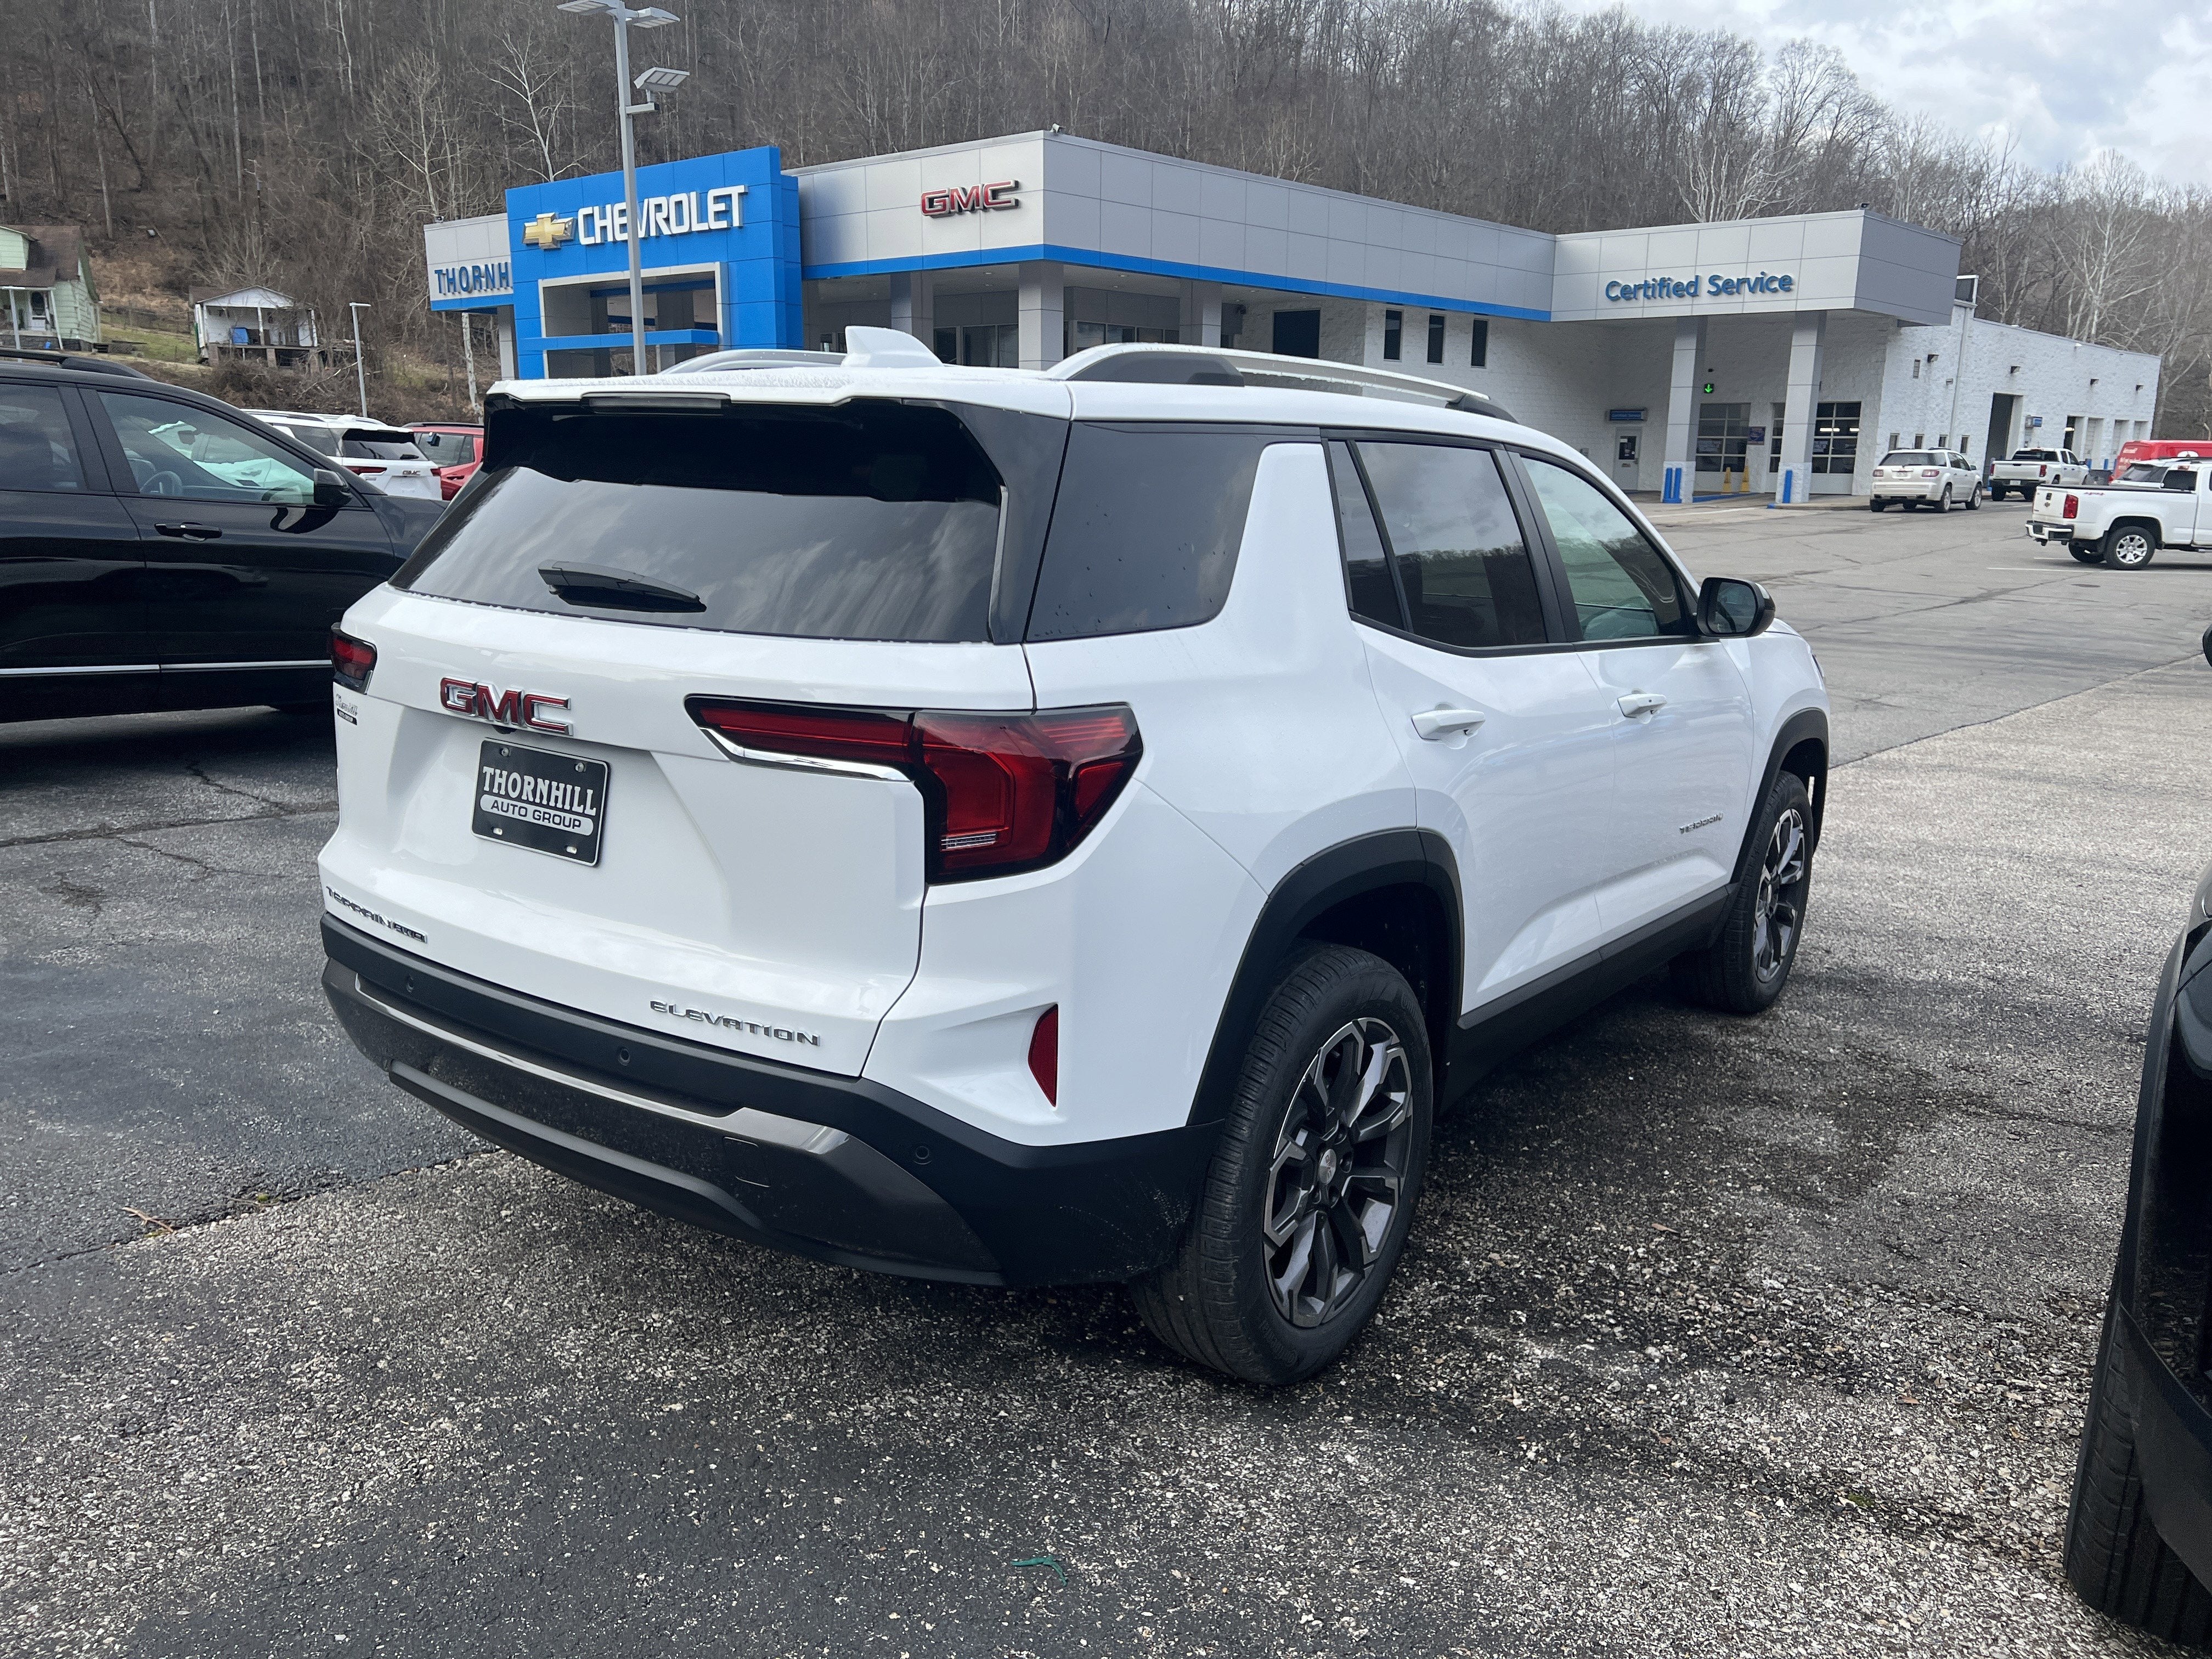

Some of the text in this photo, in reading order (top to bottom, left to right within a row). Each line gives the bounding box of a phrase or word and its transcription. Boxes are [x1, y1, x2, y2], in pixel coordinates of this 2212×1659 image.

[921, 179, 1019, 217] GMC
[1605, 271, 1794, 302] Certified Service
[440, 676, 574, 736] GMC
[482, 766, 596, 816] THORNHILL
[490, 799, 582, 830] AUTO GROUP
[326, 885, 393, 929] TERRAIN
[650, 999, 821, 1047] ELEVATION
